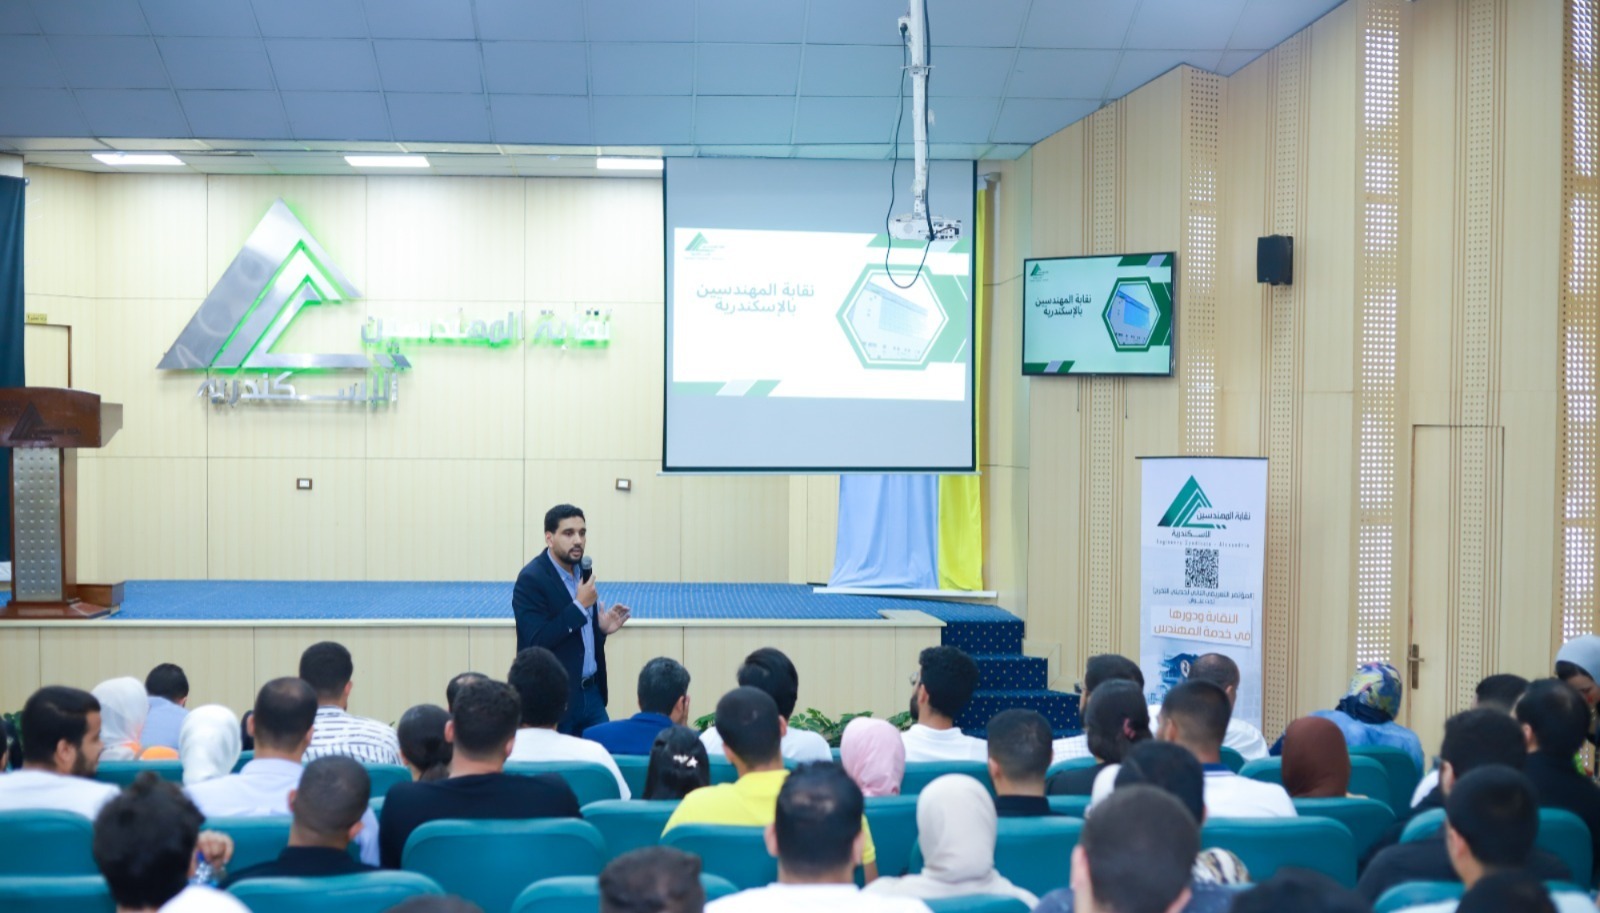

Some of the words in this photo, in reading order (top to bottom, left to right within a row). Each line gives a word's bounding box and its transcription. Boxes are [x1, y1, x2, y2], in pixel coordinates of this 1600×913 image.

[696, 283, 777, 300] المهندسين
[782, 281, 815, 301] نقابة
[1035, 294, 1074, 308] المهندسين
[1075, 293, 1092, 306] نقابة
[534, 308, 612, 350] نقابة
[1196, 511, 1234, 521] المهندسين
[1234, 511, 1251, 522] نقابة
[1156, 538, 1182, 546] Engineers
[1219, 541, 1250, 549] Alexandria
[1169, 608, 1205, 623] ودورها
[1206, 611, 1238, 624] النقابة
[1154, 623, 1202, 636] المهندس
[1203, 625, 1231, 639] خدمة
[1234, 631, 1251, 642] في
